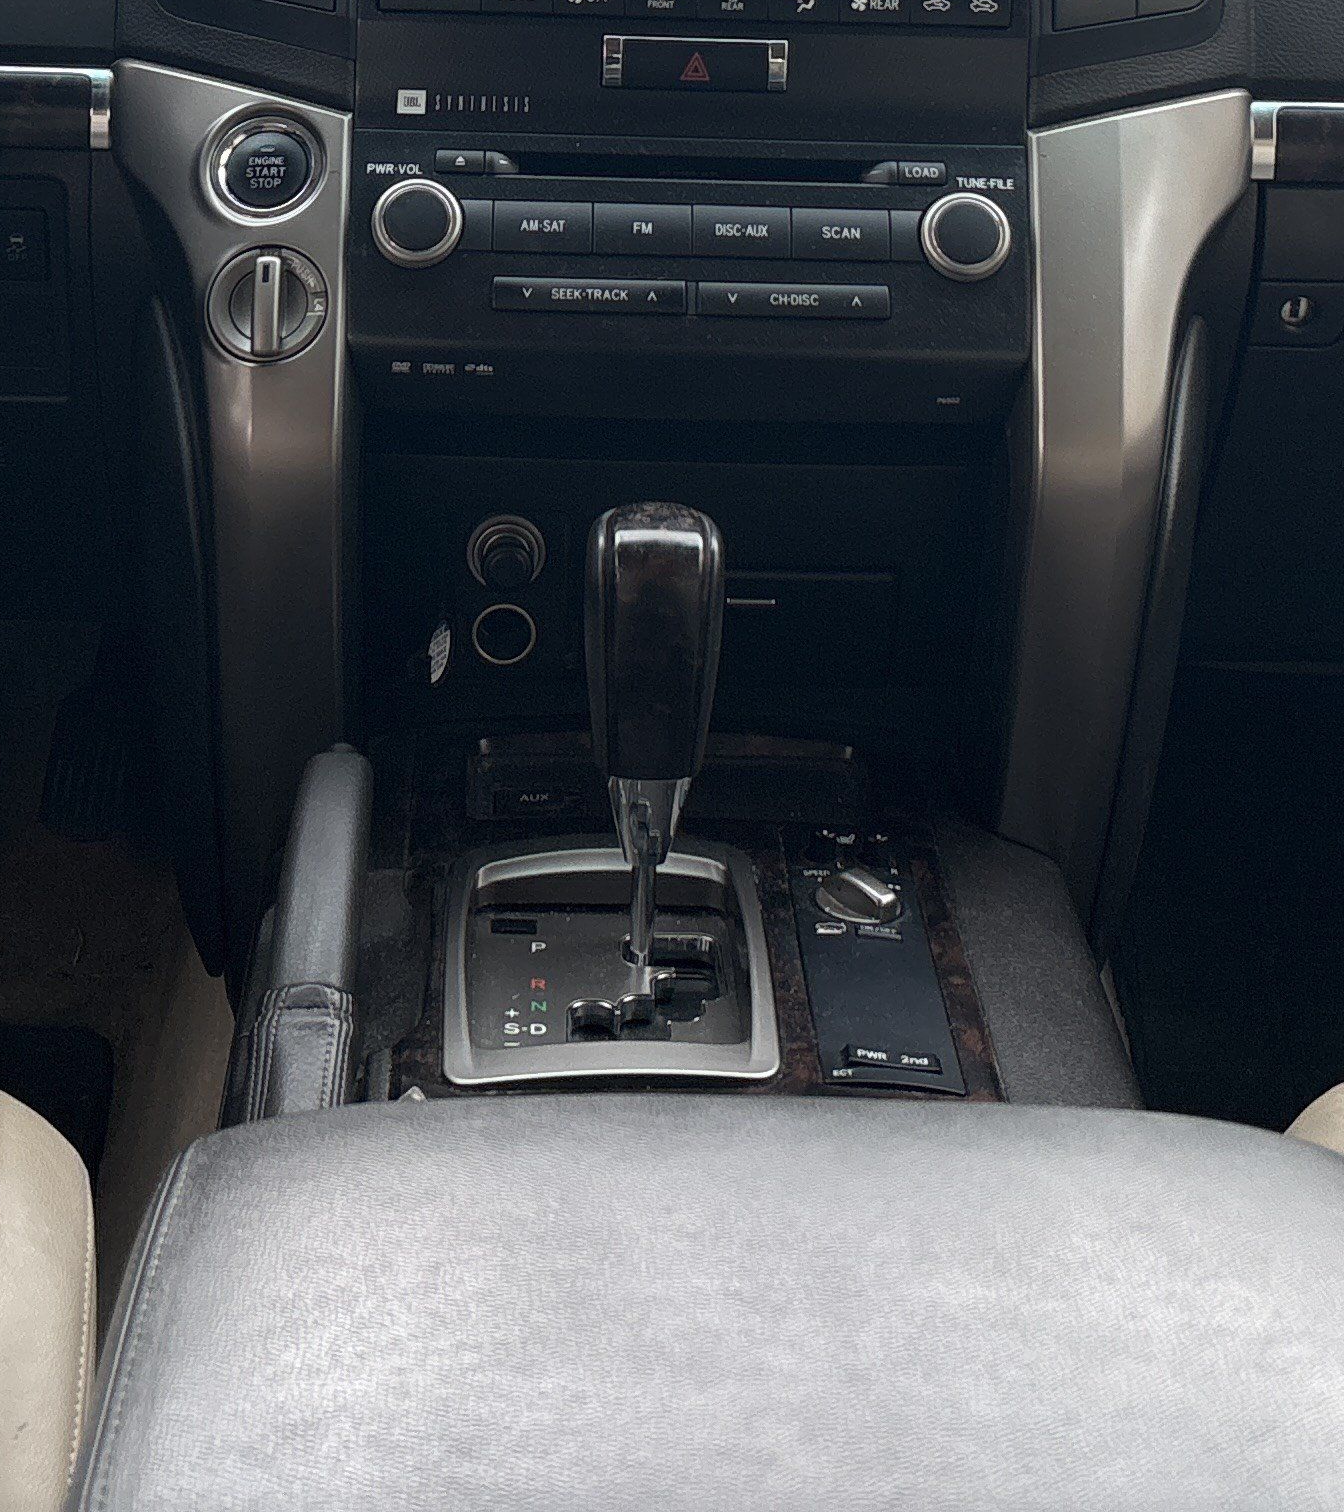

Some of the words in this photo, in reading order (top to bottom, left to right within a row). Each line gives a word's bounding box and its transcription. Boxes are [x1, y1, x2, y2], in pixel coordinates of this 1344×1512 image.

[647, 0, 675, 9] FRONT
[721, 1, 744, 11] REAR
[248, 155, 285, 166] ENGINE
[245, 166, 287, 178] START
[905, 166, 940, 178] LOAD
[249, 178, 282, 189] STOP
[633, 221, 653, 235] FM
[821, 226, 861, 239] SCAN
[519, 792, 549, 802] AUX
[530, 941, 547, 953] P
[530, 976, 547, 990] R
[530, 1000, 547, 1013] N
[856, 1048, 888, 1061] PWR
[900, 1054, 929, 1066] 2nd
